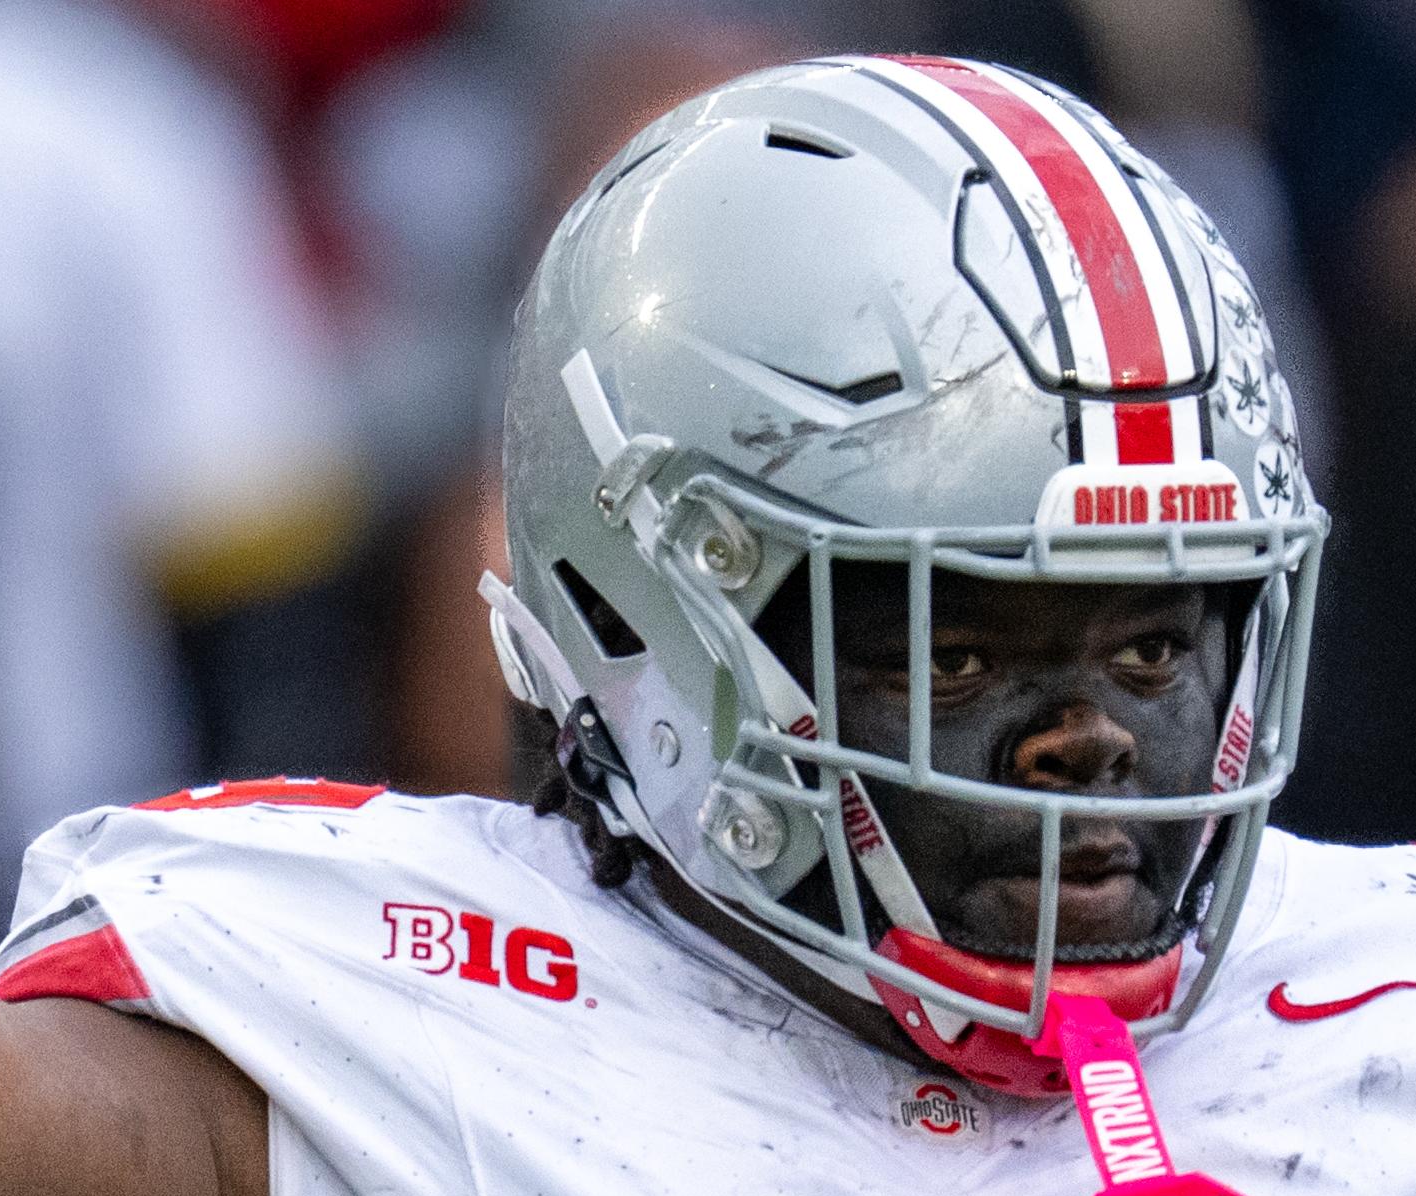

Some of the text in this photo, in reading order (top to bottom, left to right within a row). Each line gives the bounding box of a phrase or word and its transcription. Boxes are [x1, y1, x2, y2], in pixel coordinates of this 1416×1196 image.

[1074, 483, 1238, 524] OHIO STATE
[1218, 703, 1253, 782] STATE
[1079, 1059, 1168, 1185] NXTRND
